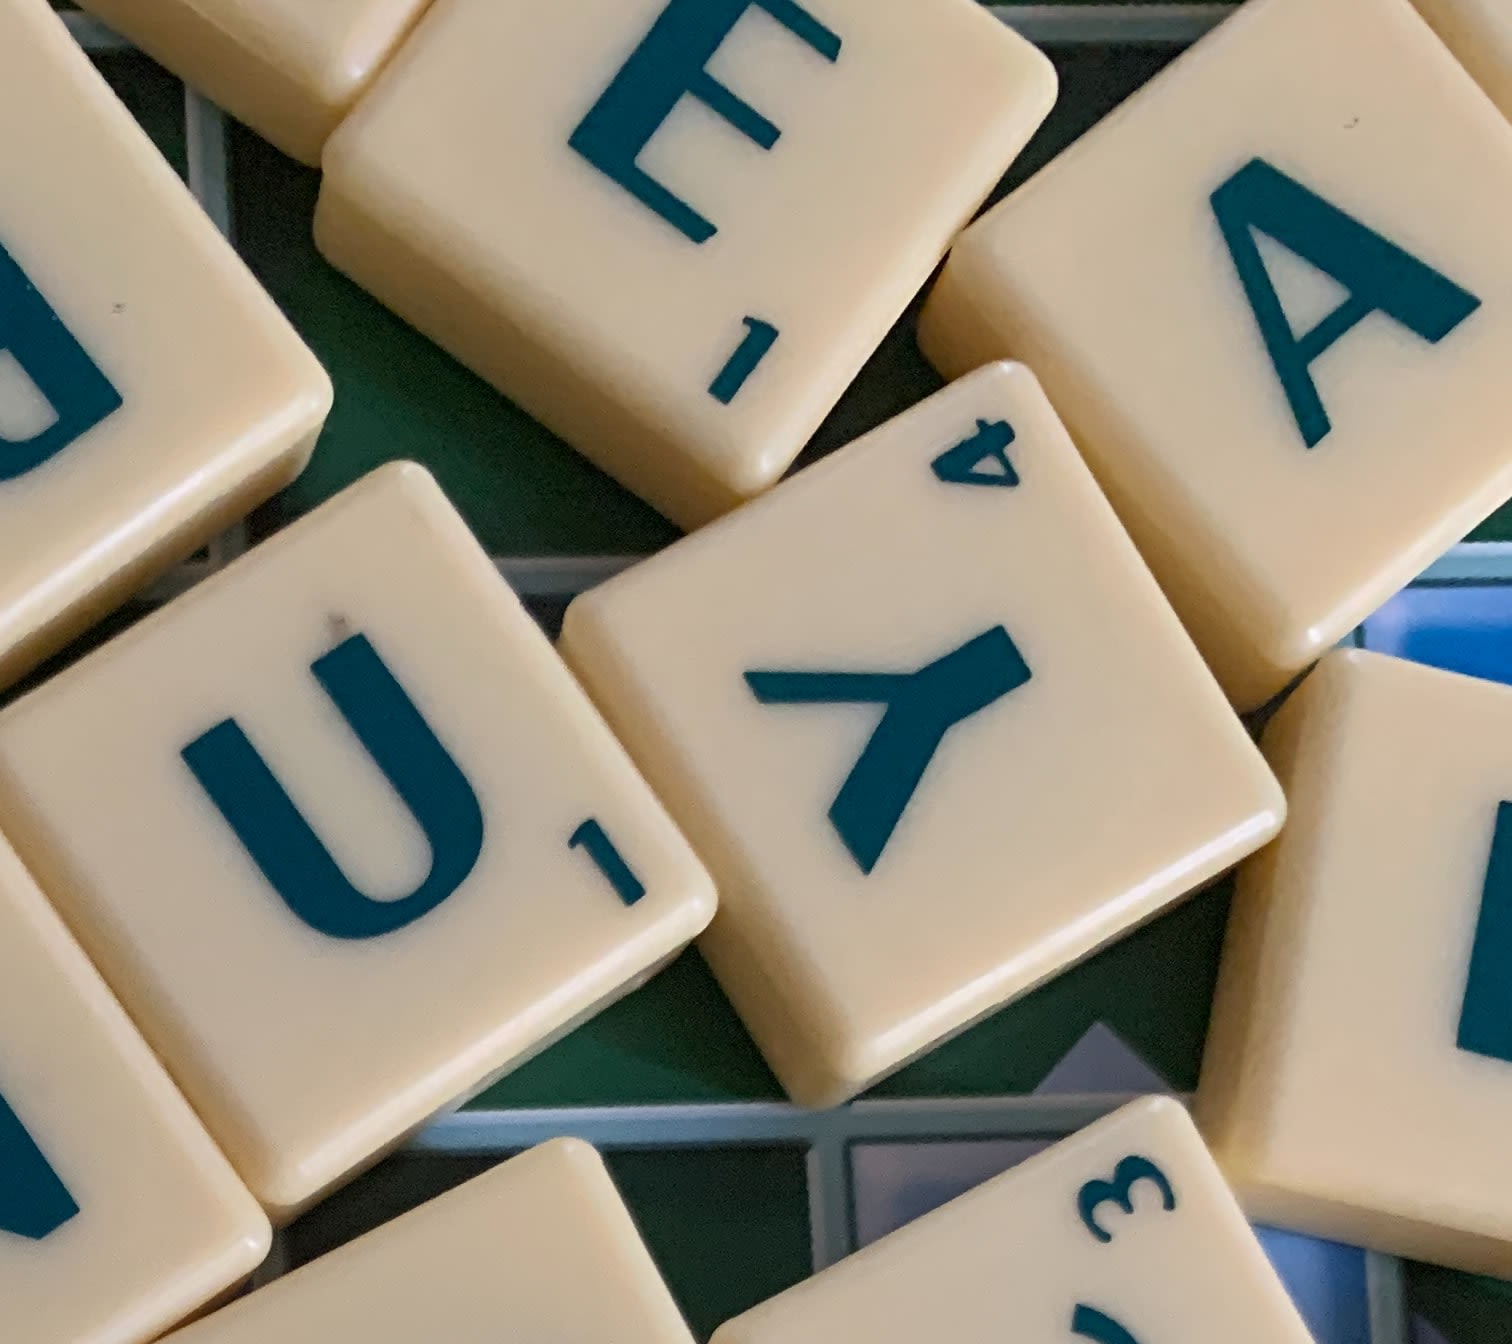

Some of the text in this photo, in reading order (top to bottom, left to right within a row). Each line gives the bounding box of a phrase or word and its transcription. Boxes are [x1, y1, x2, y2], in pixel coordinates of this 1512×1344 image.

[568, 0, 840, 243] E
[708, 316, 778, 403] 1
[1210, 157, 1480, 448] A
[931, 419, 1019, 487] 4
[182, 634, 483, 939] U
[745, 625, 1031, 873] Y
[568, 819, 645, 905] 1
[1078, 1155, 1174, 1241] 3
